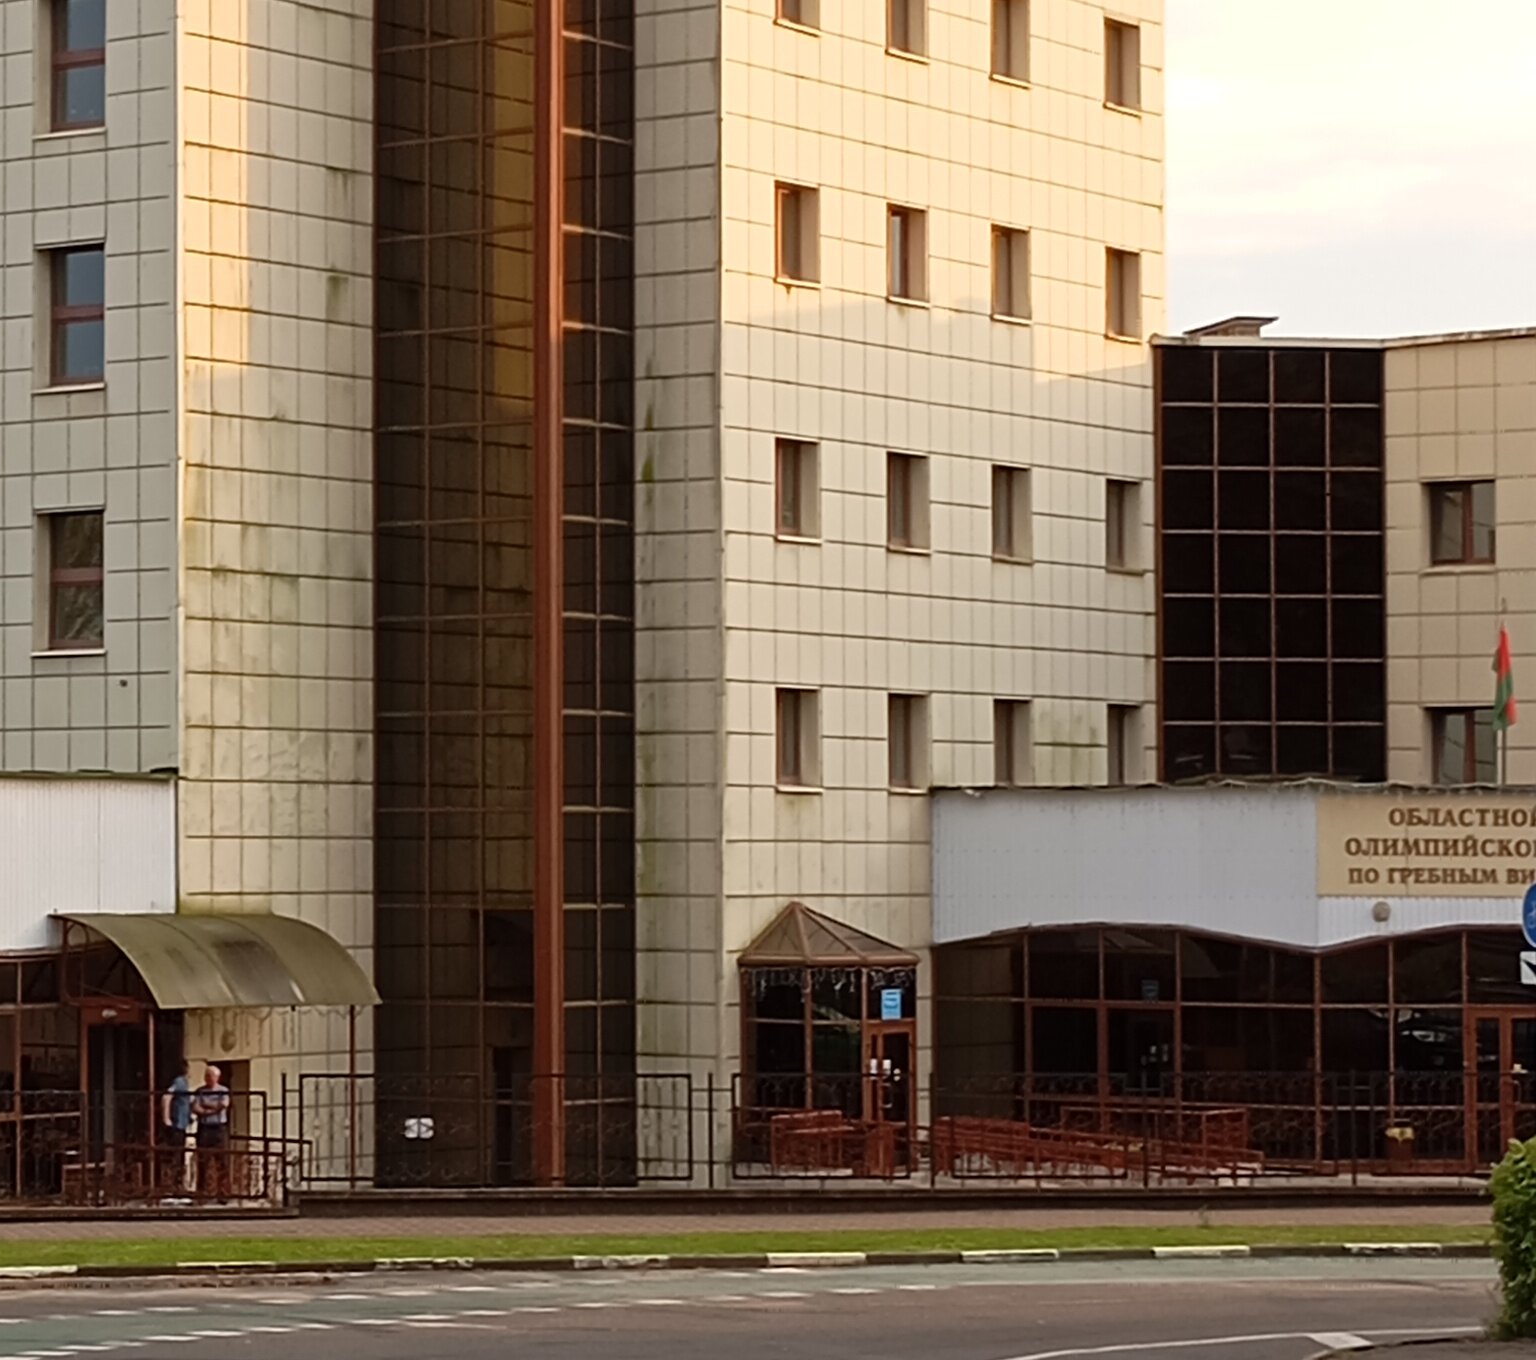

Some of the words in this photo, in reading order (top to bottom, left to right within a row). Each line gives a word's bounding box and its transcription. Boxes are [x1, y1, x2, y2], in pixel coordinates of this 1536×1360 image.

[1345, 835, 1536, 858] ОЛИМПИЙСКО
[1348, 867, 1379, 885] ПО
[1387, 867, 1498, 885] ГРЕБНЫМ
